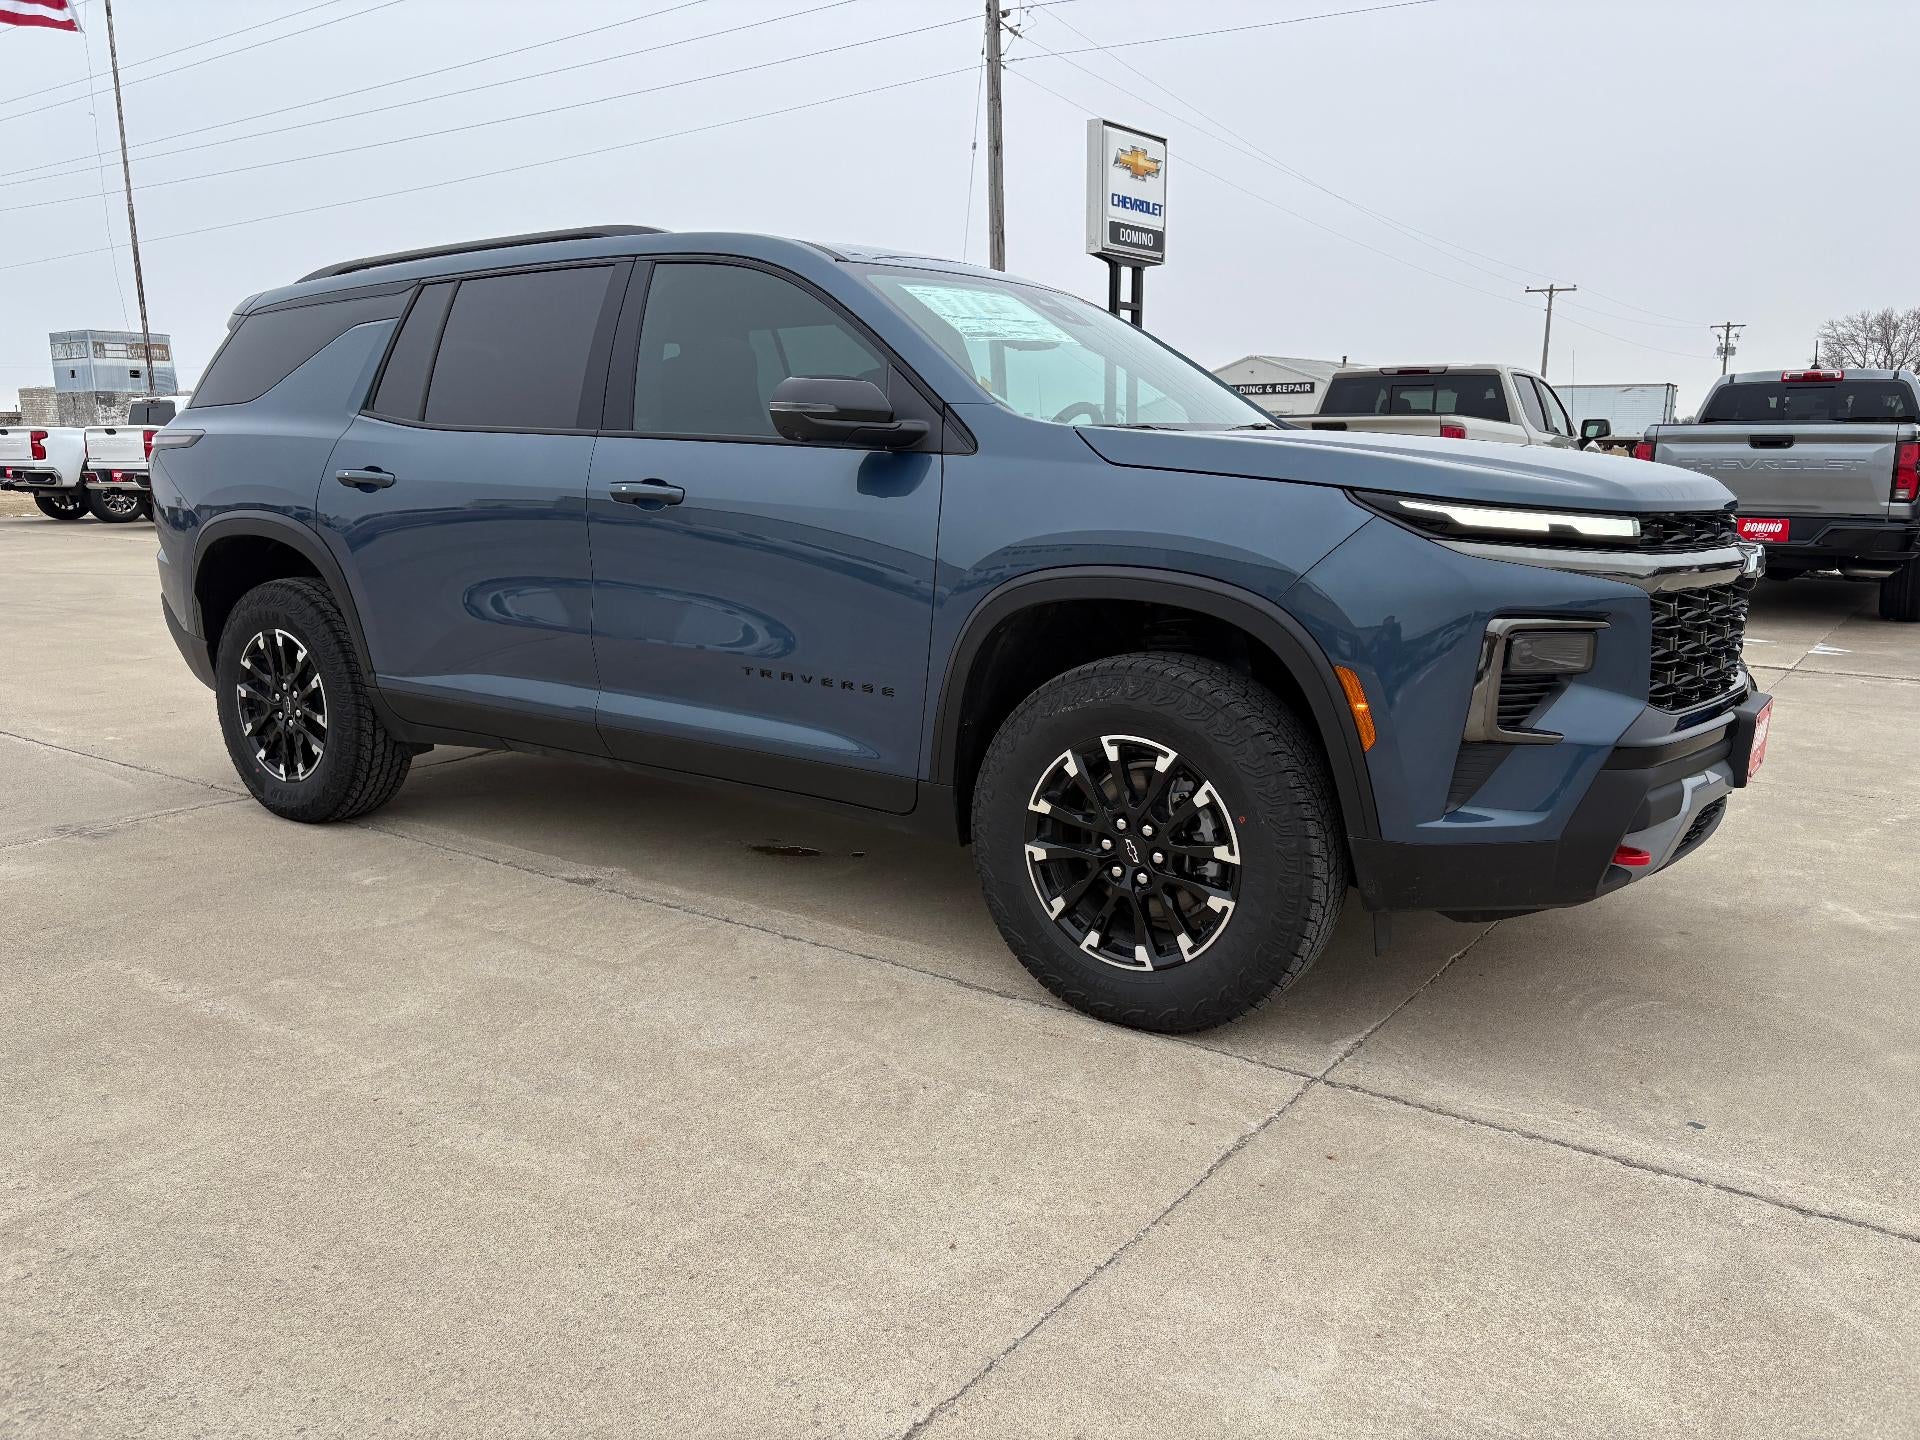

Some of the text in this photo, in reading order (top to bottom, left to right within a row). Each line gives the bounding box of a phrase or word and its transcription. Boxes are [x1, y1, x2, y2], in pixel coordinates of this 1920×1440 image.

[1111, 193, 1163, 217] CHEVROLET
[1119, 228, 1154, 247] DOMINO
[1235, 384, 1311, 394] DING & REPAIR
[1677, 457, 1867, 471] CHEVROLET
[1743, 522, 1783, 533] DOMINO
[742, 666, 895, 698] TRAVERSE
